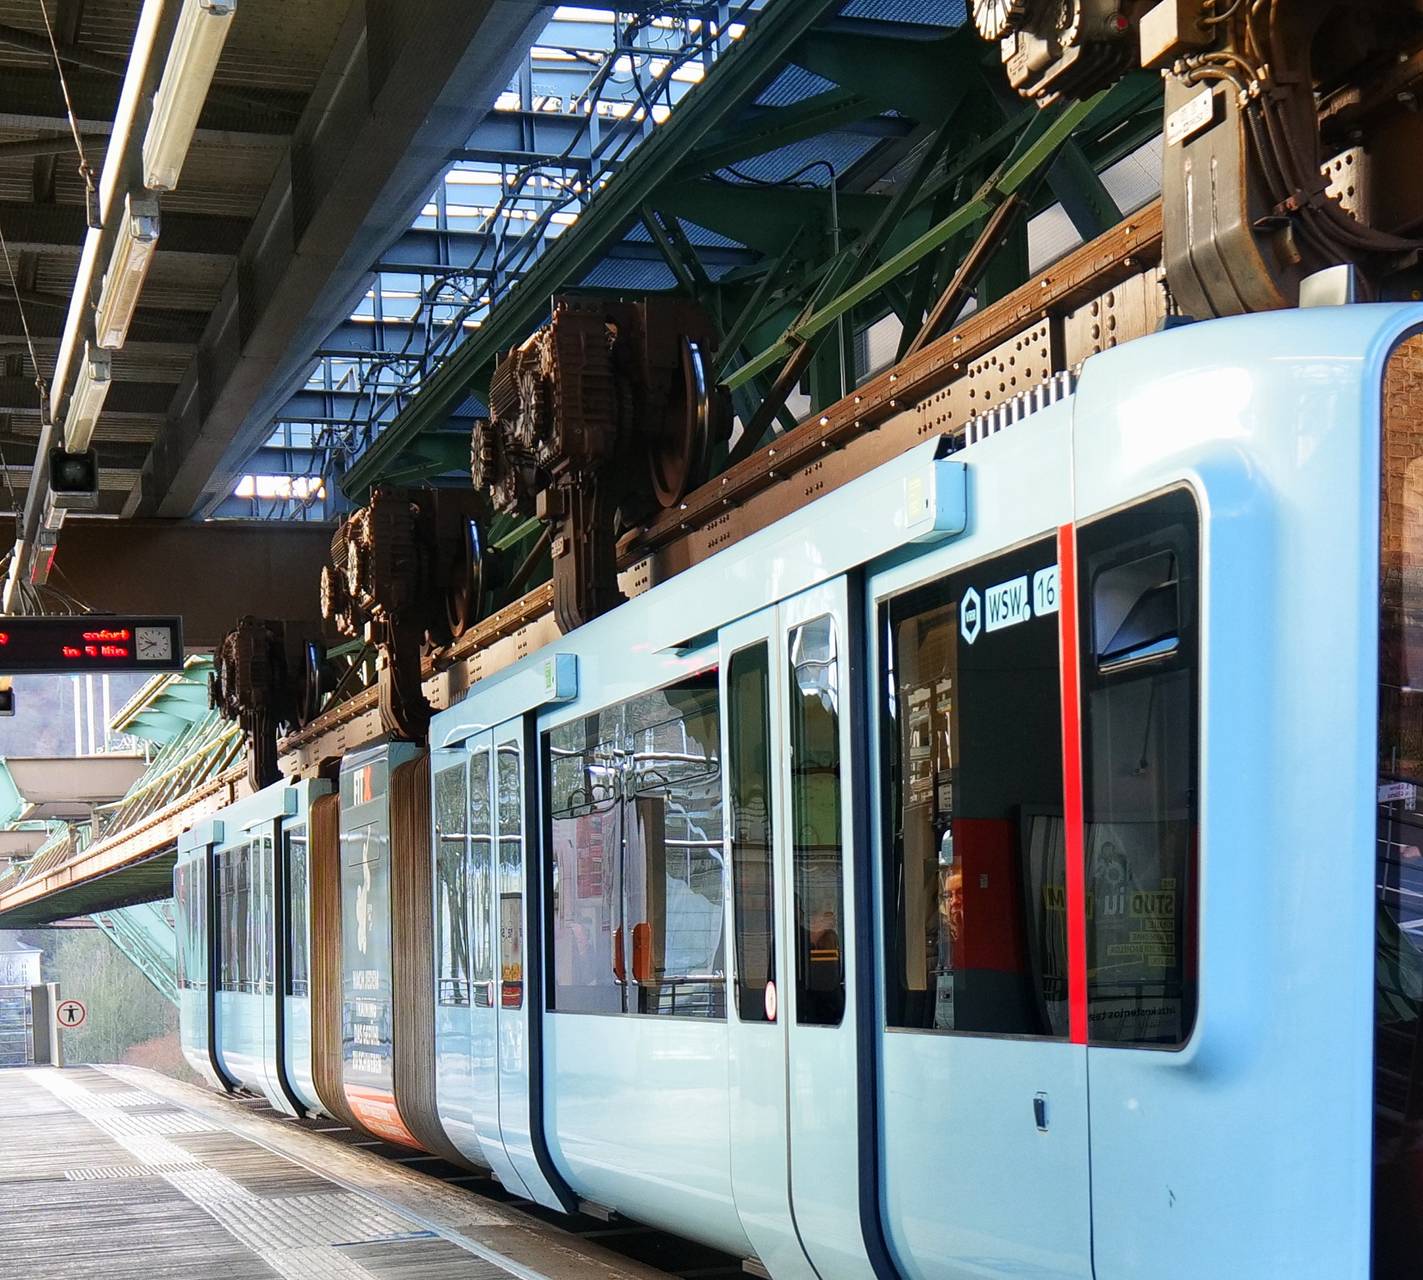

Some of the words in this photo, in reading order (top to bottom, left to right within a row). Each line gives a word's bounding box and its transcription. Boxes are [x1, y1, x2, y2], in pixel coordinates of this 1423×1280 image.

[1037, 573, 1055, 608] 16
[82, 629, 130, 641] sofort
[62, 645, 80, 657] in
